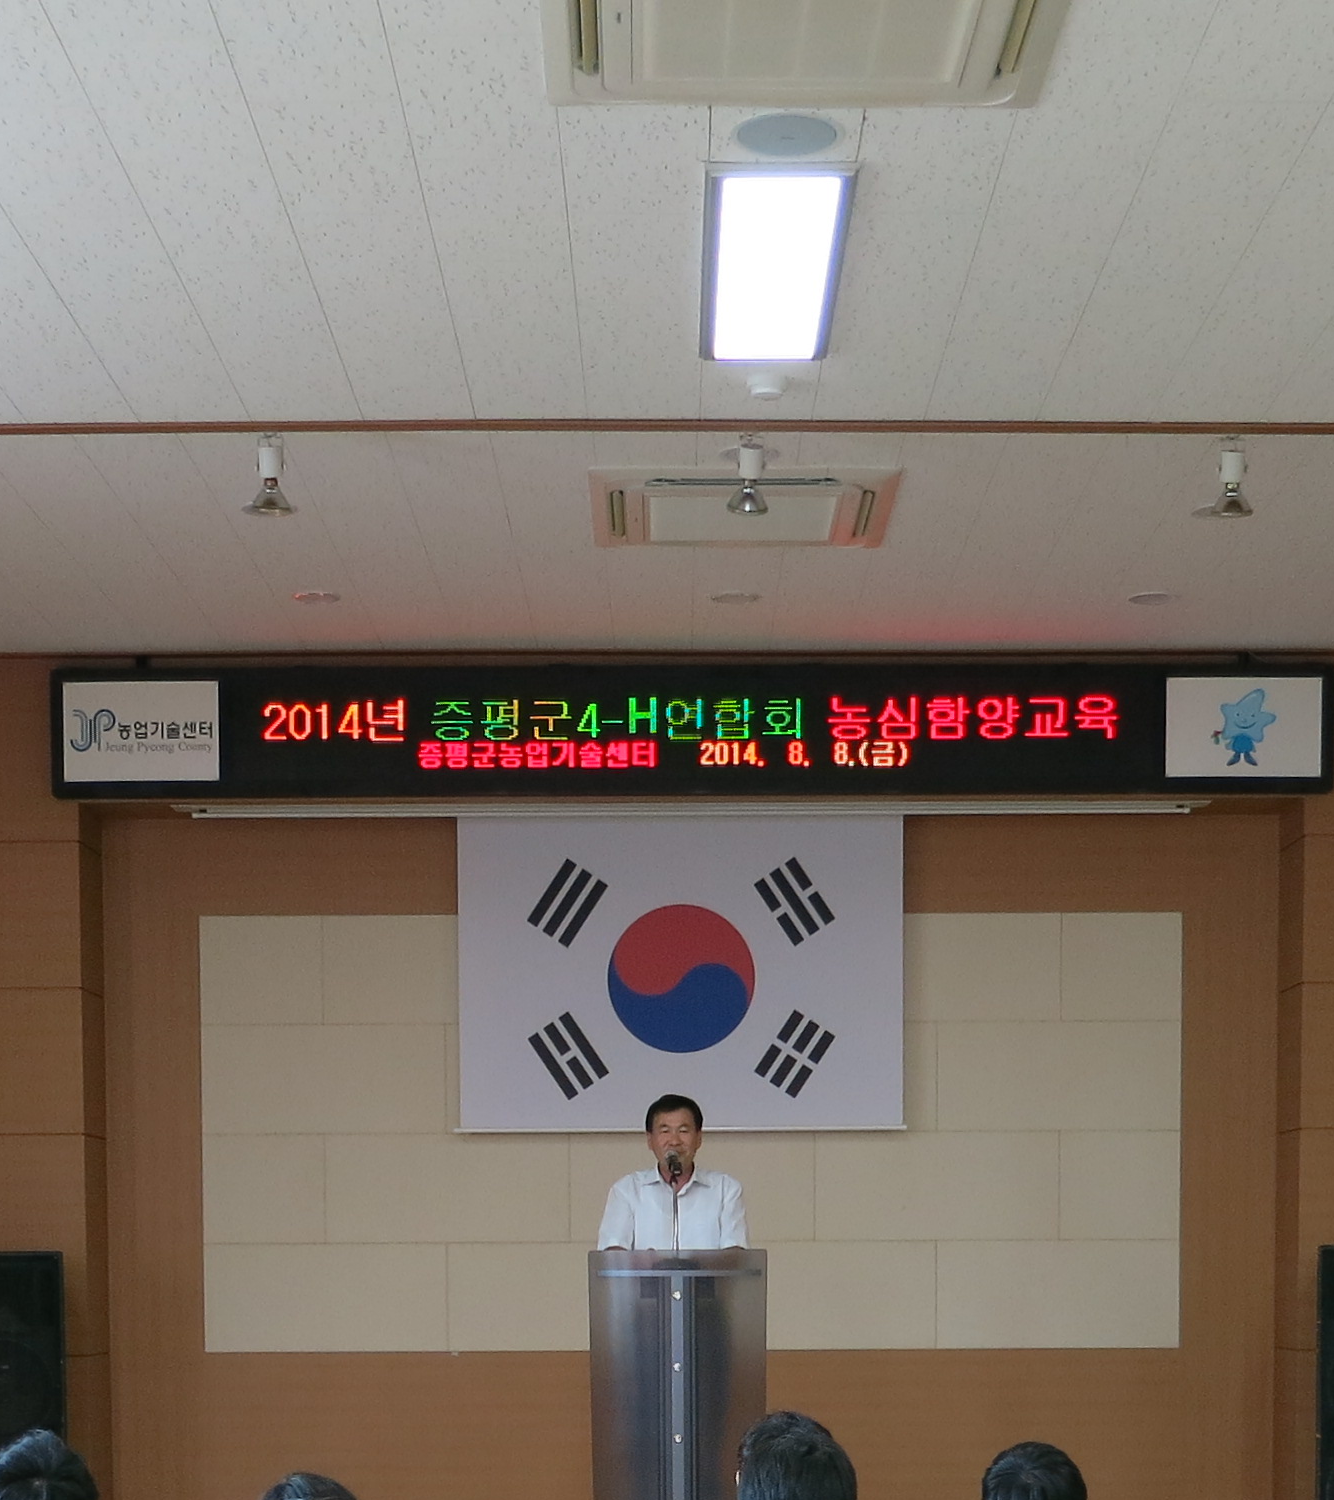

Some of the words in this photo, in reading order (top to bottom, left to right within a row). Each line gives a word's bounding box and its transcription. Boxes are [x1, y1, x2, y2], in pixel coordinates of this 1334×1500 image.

[118, 721, 214, 740] 농업기술센터
[263, 698, 405, 742] 2014년
[431, 697, 802, 740] 증평군4-H연합회
[828, 697, 1118, 739] 농심함양교육
[418, 742, 656, 769] 증평군농업기술센터
[700, 741, 766, 767] 2014.
[787, 741, 810, 767] 8.
[833, 741, 909, 767] 8.(금)
